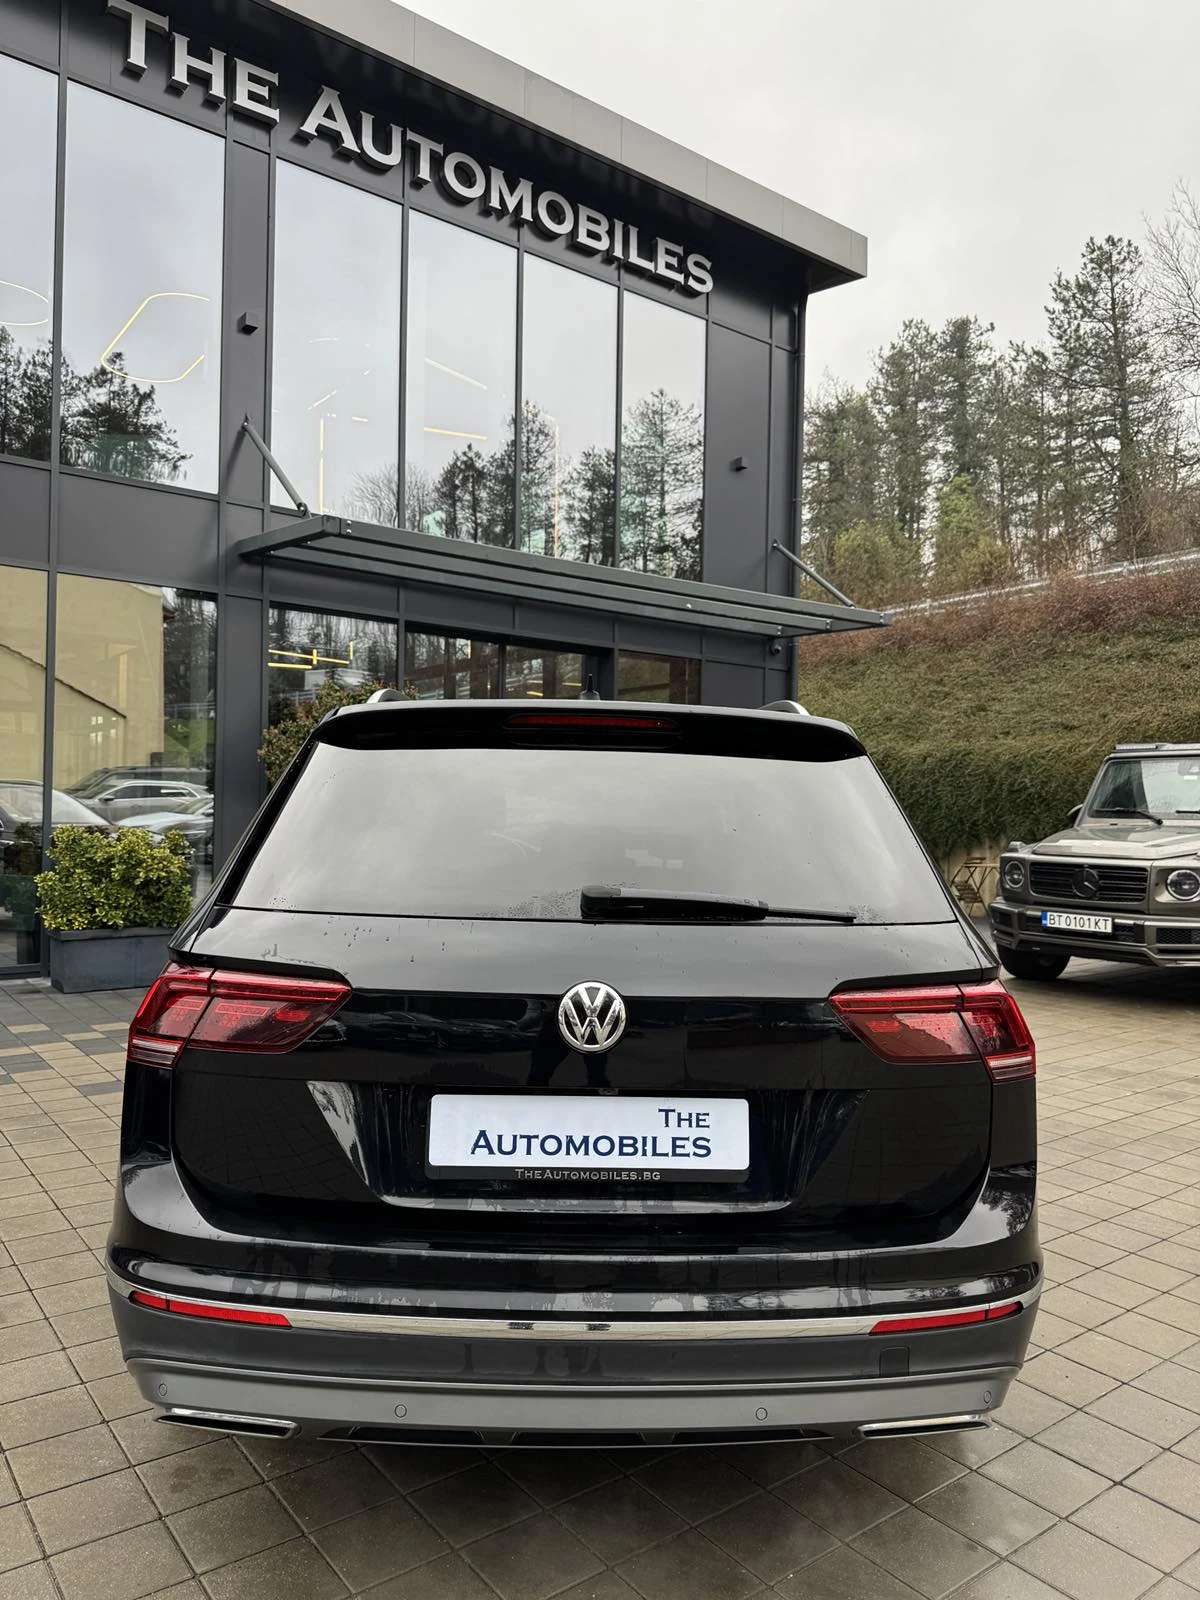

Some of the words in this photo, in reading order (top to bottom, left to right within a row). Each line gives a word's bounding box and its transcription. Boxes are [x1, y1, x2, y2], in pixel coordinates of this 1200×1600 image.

[108, 0, 280, 123] THE
[300, 85, 714, 295] AUTOMOBILES
[1049, 914, 1063, 925] BT
[1065, 915, 1092, 928] 0101
[1094, 918, 1109, 930] KT
[658, 1108, 710, 1128] THE
[470, 1129, 712, 1158] AUTOMOBILES
[515, 1168, 661, 1181] THEAUTOMOBILES.BG
